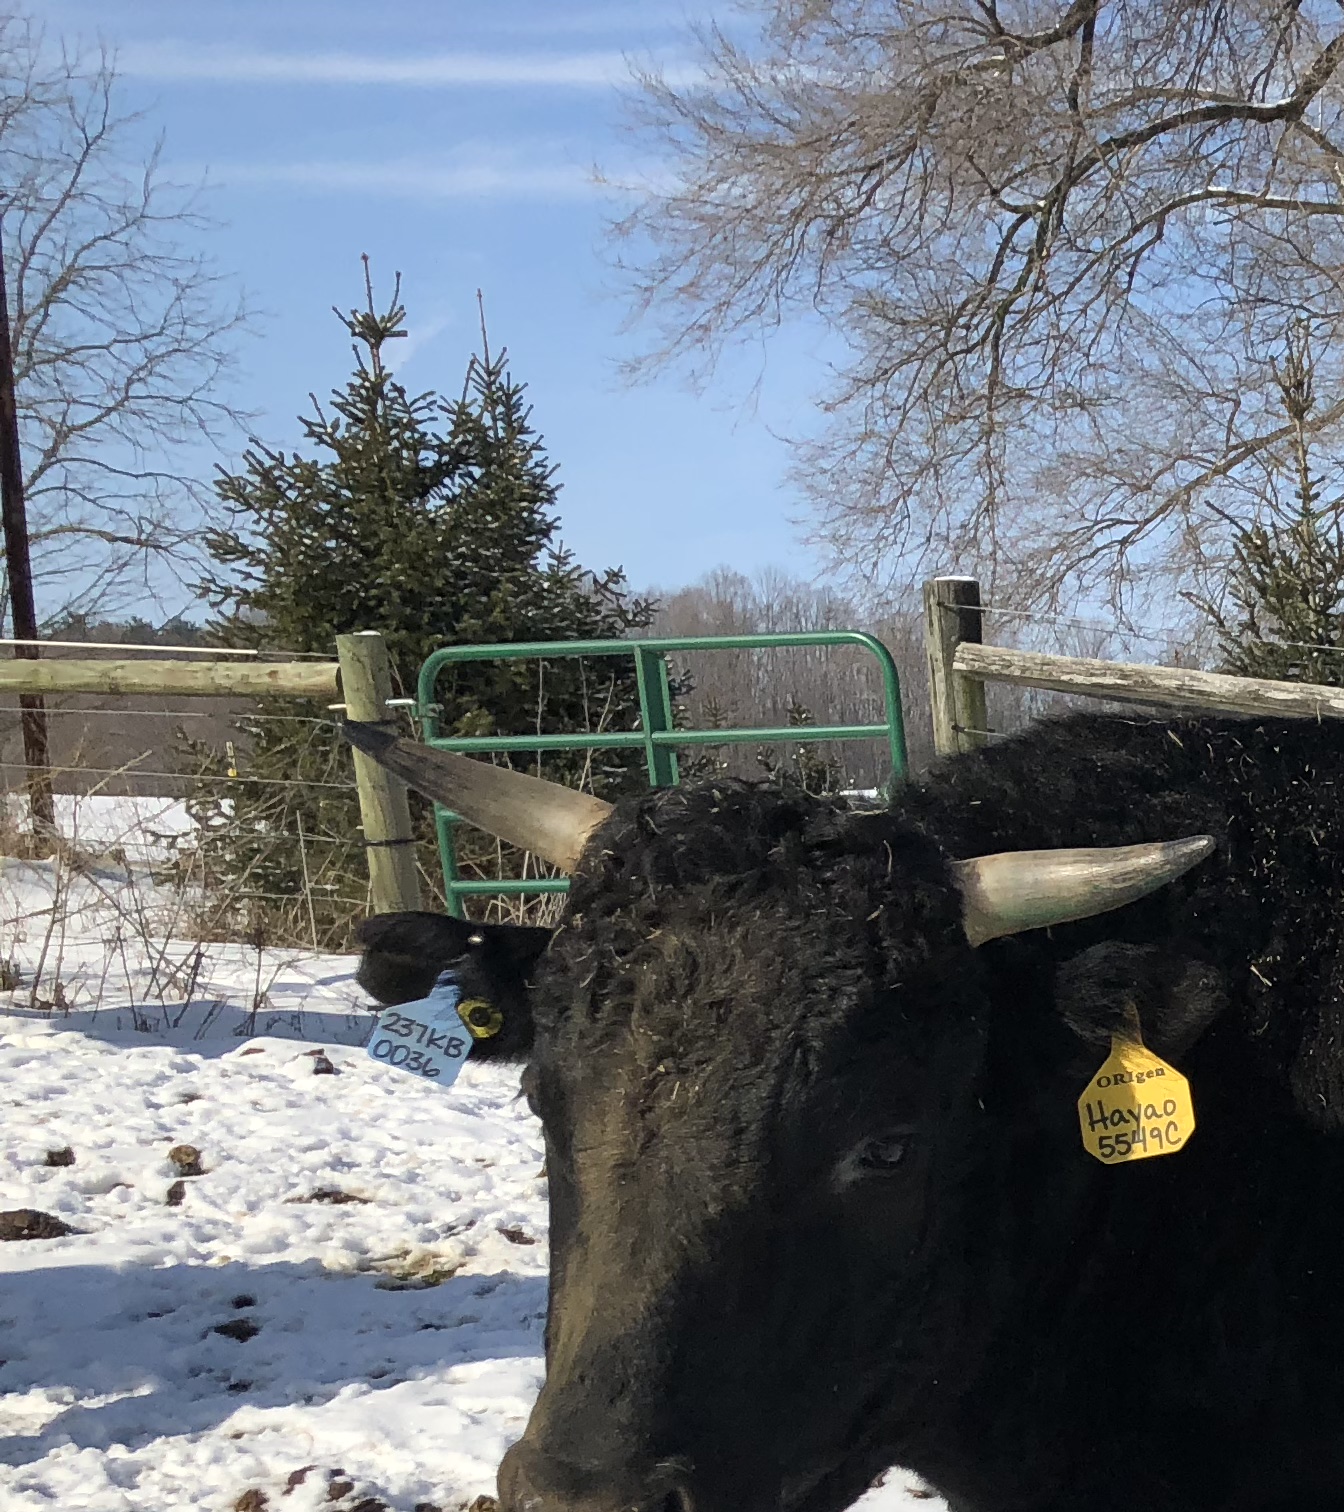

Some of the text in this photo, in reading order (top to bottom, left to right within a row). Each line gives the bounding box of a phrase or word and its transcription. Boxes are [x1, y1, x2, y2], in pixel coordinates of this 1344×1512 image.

[373, 1040, 440, 1077] 0036
[1086, 1099, 1176, 1132] Hayao
[1099, 1121, 1181, 1158] 5549C
